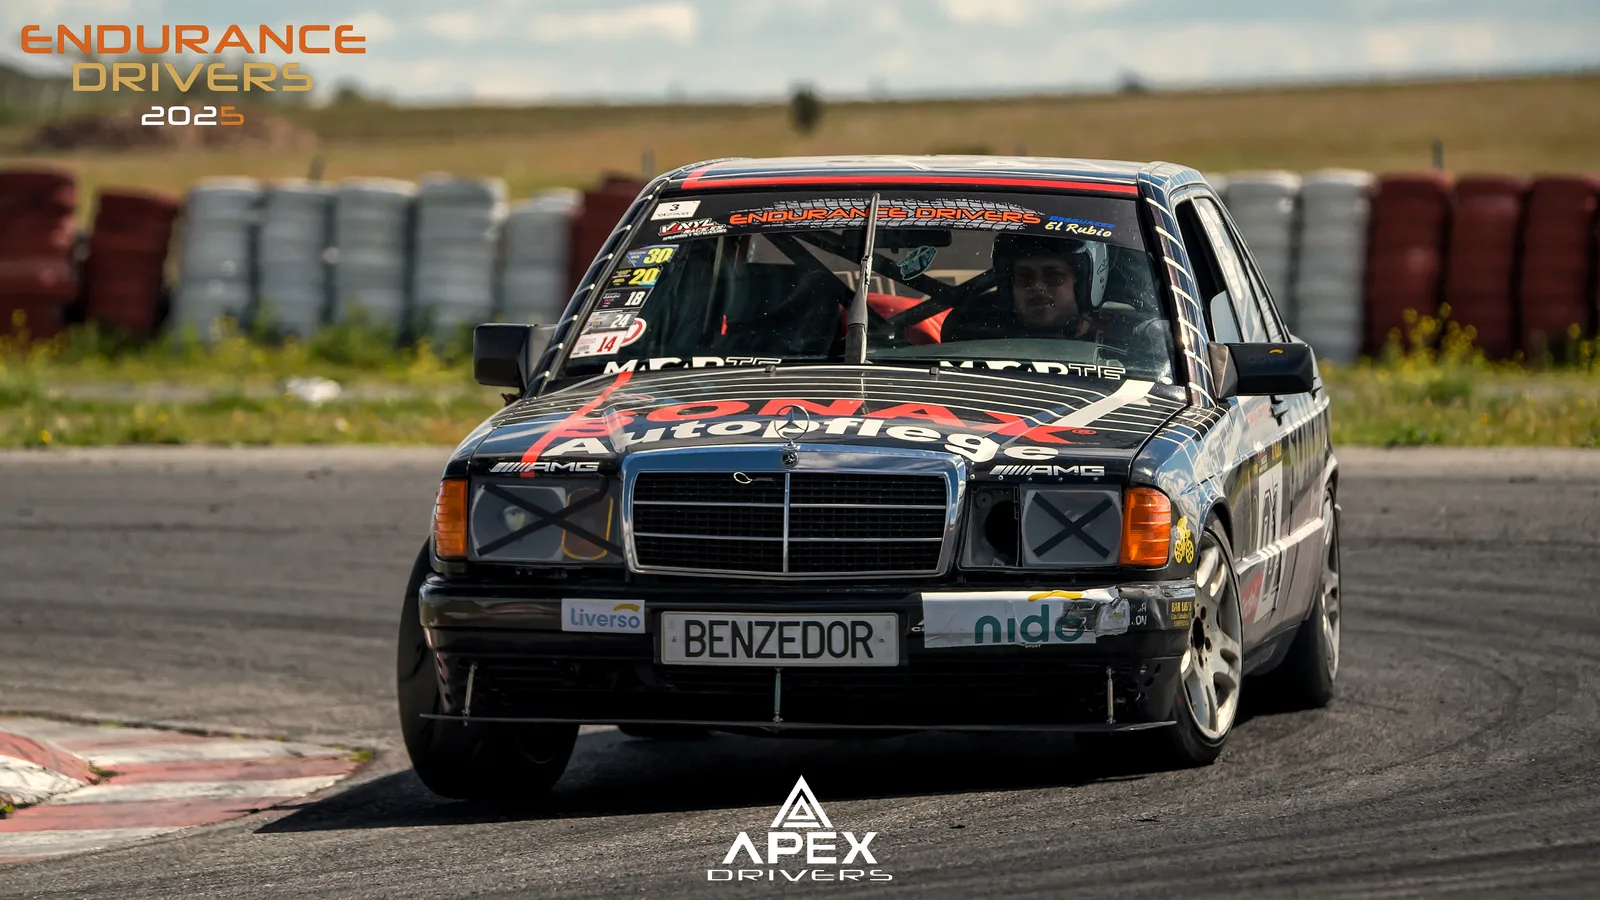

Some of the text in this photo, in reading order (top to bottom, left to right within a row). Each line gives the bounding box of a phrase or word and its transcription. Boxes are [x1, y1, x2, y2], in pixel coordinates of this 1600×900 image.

[669, 203, 680, 212] 3
[729, 207, 1041, 225] ENDURANCE DRIVERS
[1045, 221, 1112, 237] El Rubio
[643, 247, 673, 264] 30
[628, 268, 659, 286] 20
[625, 291, 646, 306] 18
[610, 313, 632, 328] 24
[597, 336, 617, 352] 14
[540, 416, 1060, 463] Autopflege
[975, 604, 1085, 643] nido
[685, 619, 874, 658] BENZEDOR
